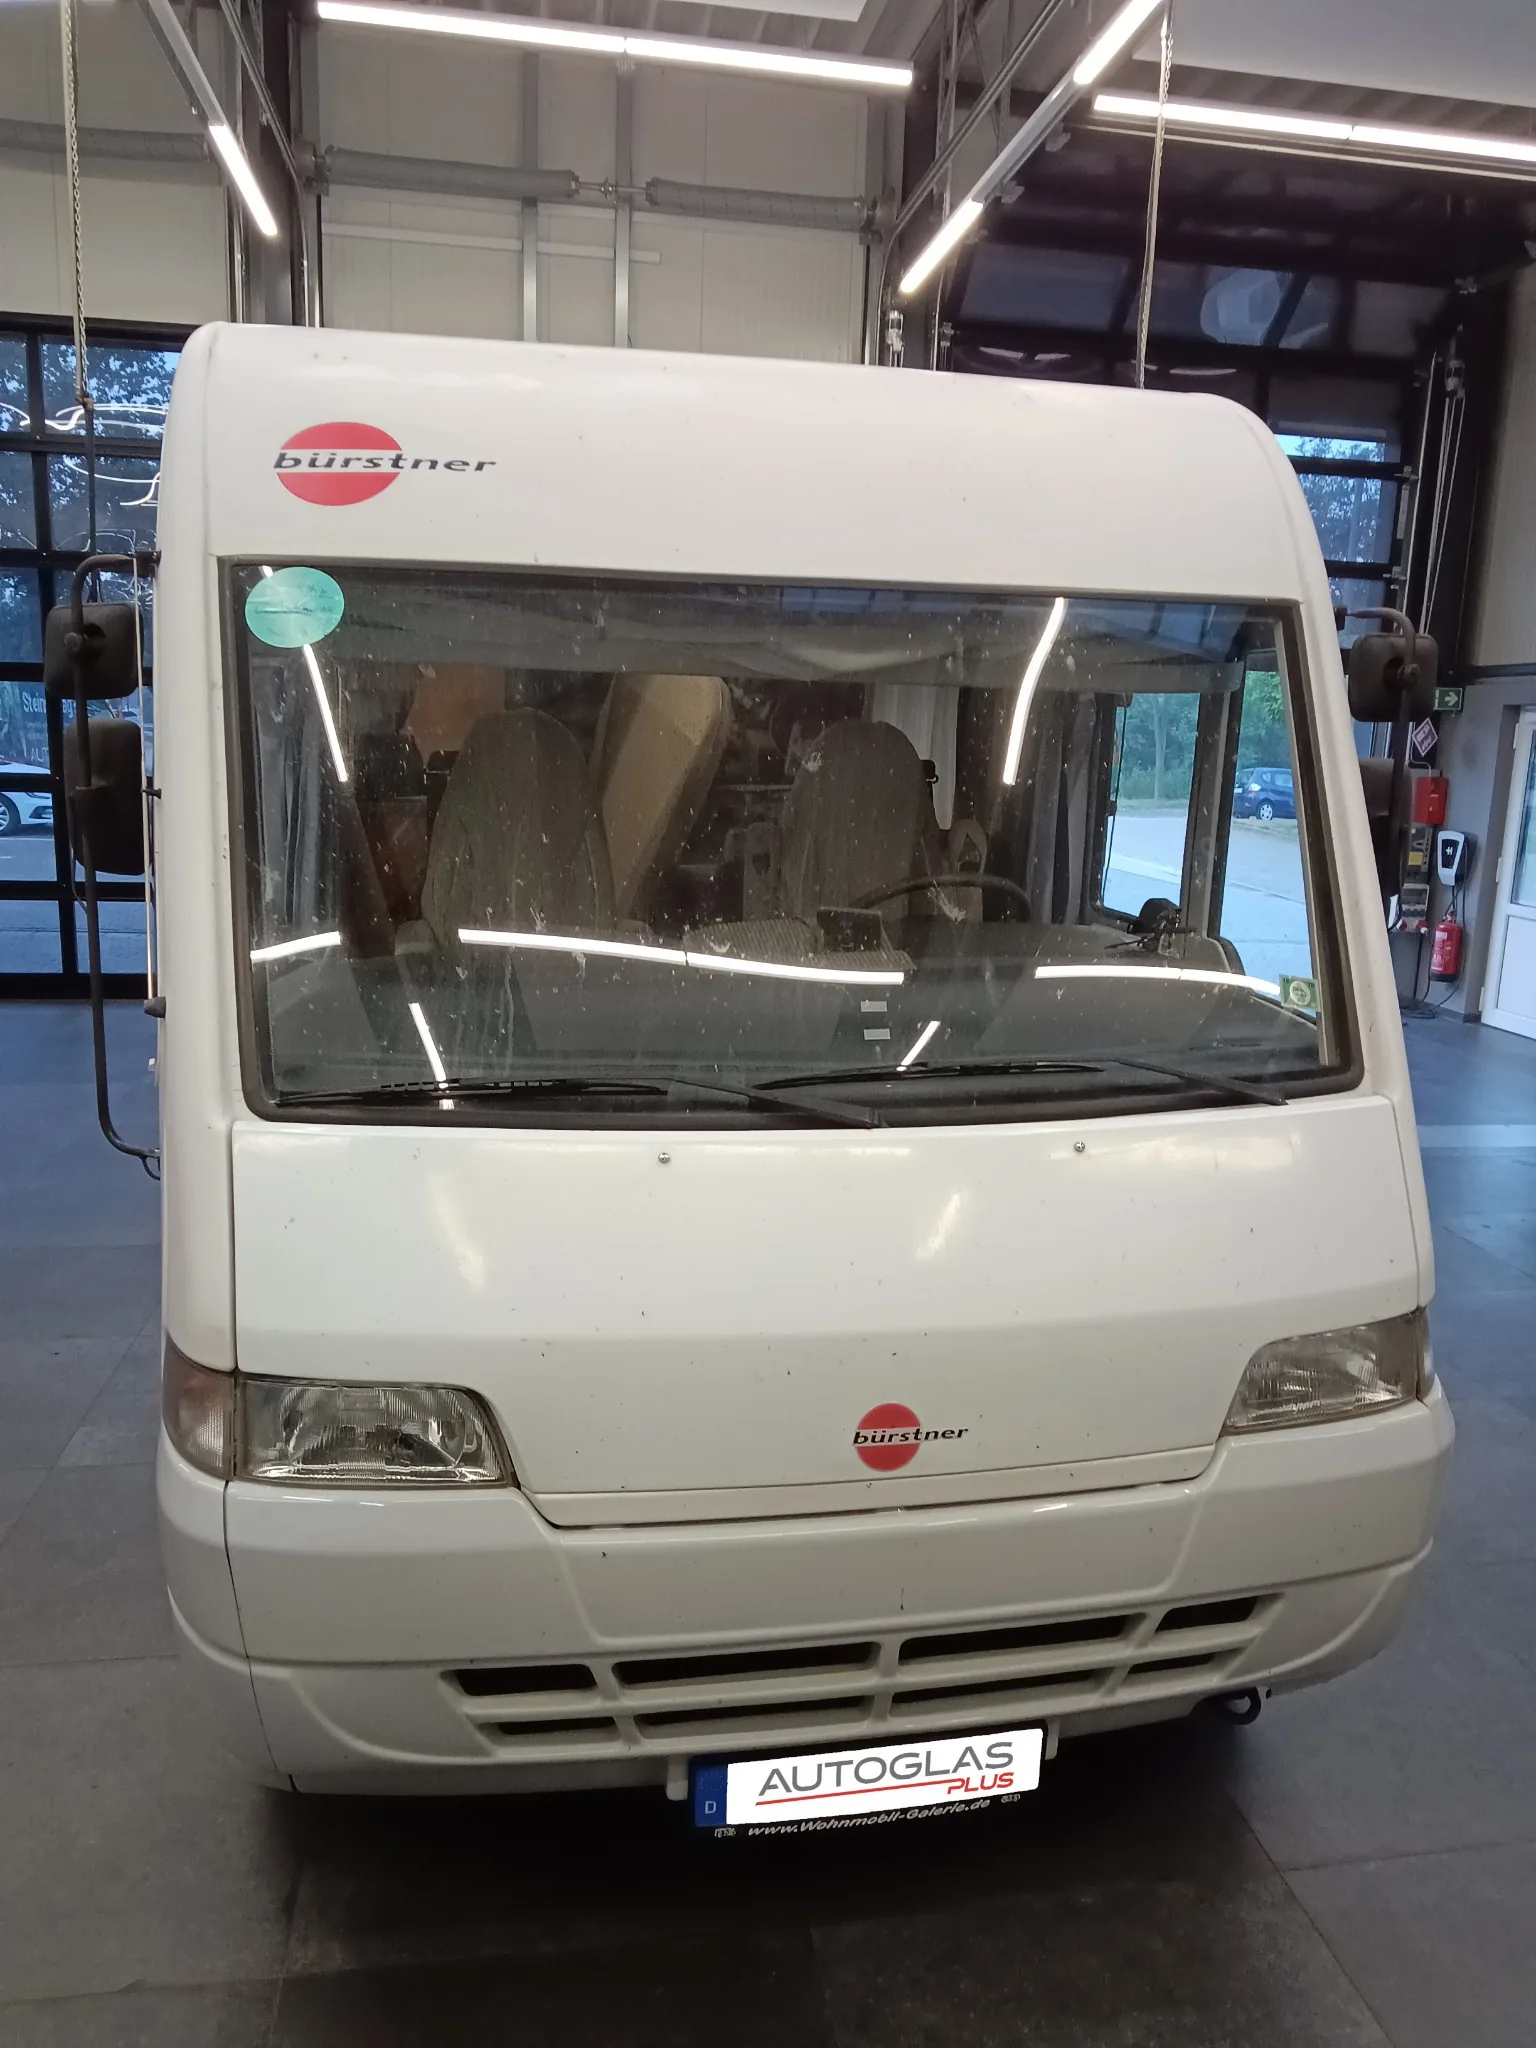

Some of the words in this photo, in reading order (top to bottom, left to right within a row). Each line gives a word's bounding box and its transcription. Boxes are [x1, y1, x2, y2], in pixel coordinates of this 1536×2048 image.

[273, 452, 497, 472] bürstner
[853, 1428, 969, 1445] bürstner
[704, 1800, 717, 1814] D
[748, 1799, 991, 1836] www.Wohnmobil-Galerie.de
